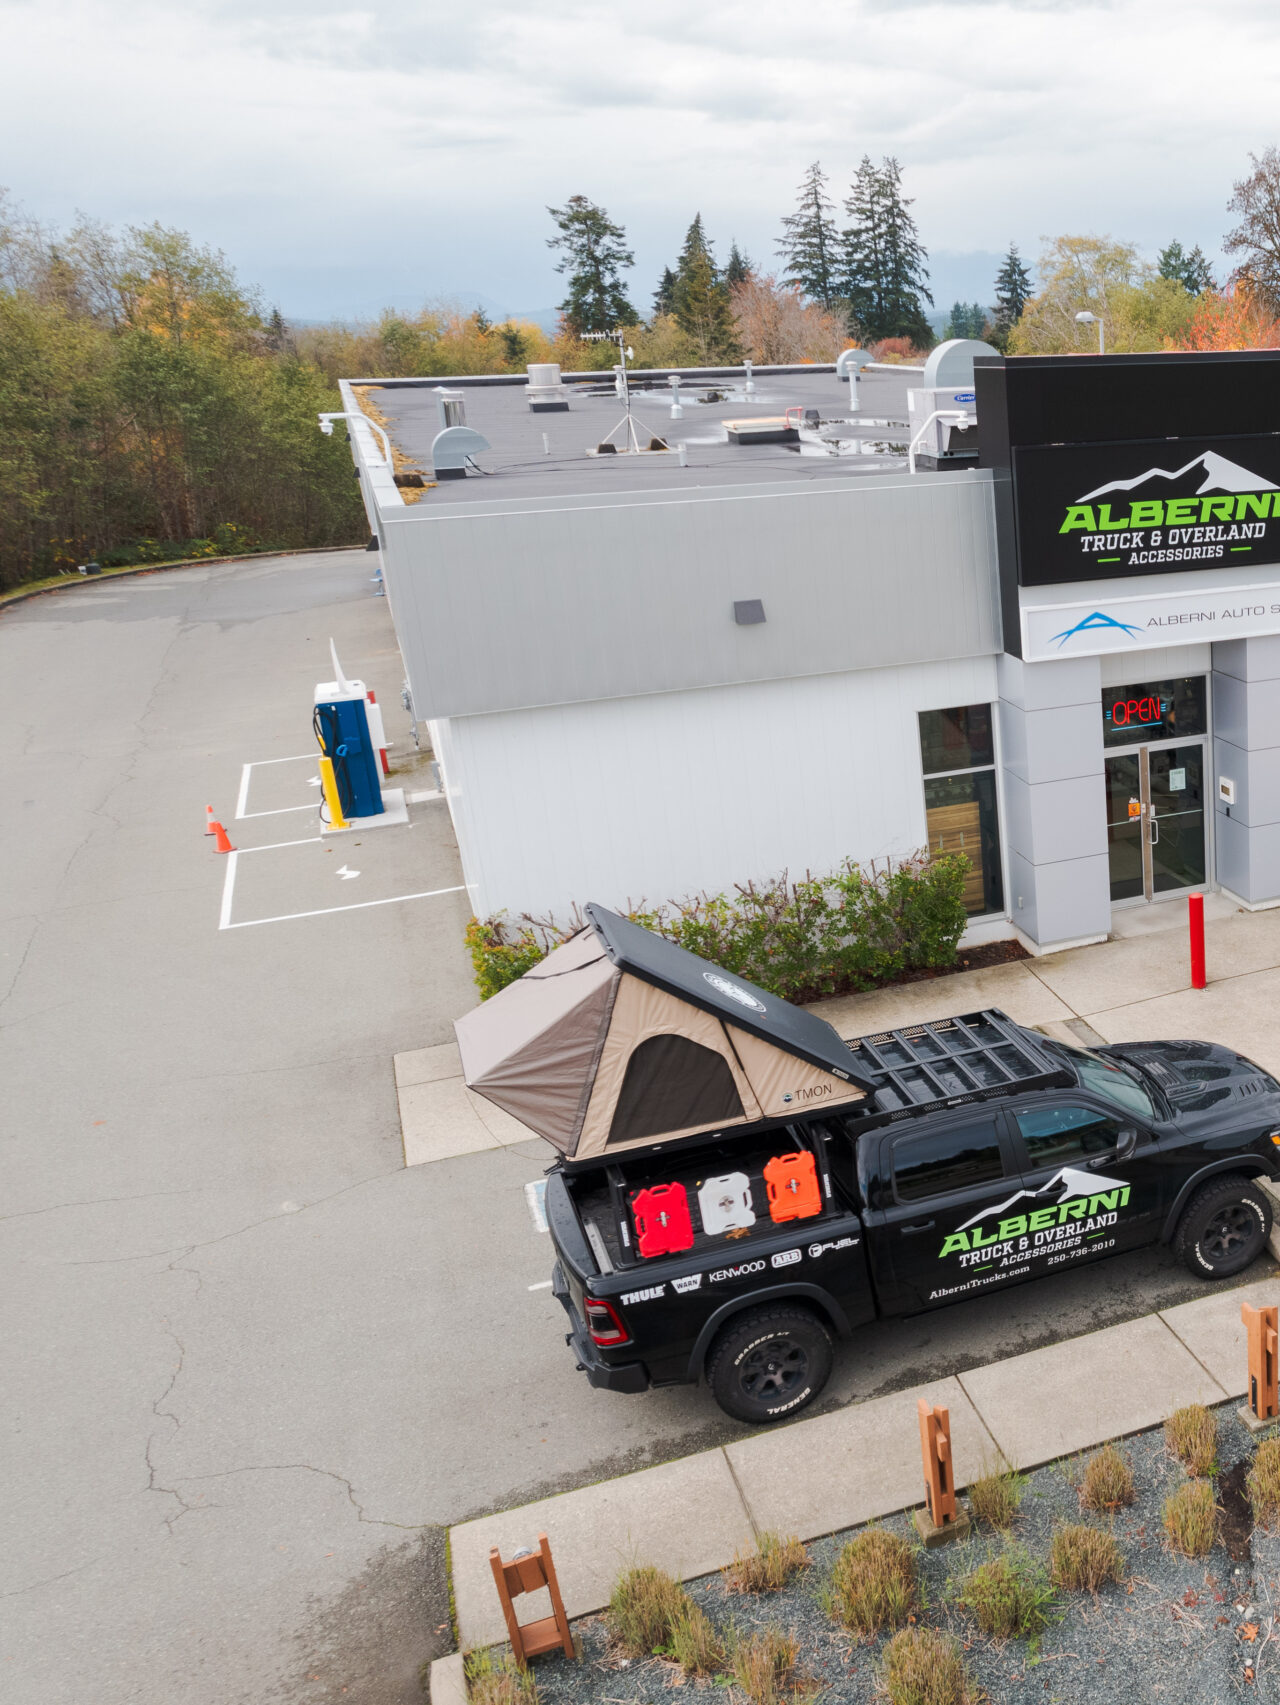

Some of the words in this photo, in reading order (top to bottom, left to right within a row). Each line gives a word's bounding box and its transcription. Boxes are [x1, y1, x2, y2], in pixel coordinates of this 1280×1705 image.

[1080, 531, 1145, 552] TRUCK
[1150, 530, 1162, 546] &
[1168, 522, 1266, 545] OVERLAND
[1128, 545, 1224, 565] ACCESSORIES
[1146, 612, 1216, 628] ALBERNI
[1221, 605, 1266, 620] AUTO
[1112, 697, 1160, 725] OPEN
[938, 1186, 1131, 1259] ALBERNI
[958, 1240, 1014, 1268] TRUCK
[1018, 1236, 1030, 1250] &
[1034, 1211, 1118, 1246] OVERLAND
[999, 1236, 1082, 1267] ACCESSORIES
[1047, 1238, 1116, 1266] 250-736-2010
[709, 1260, 766, 1283] KENWOOD
[773, 1251, 799, 1267] ARB
[620, 1285, 665, 1305] THULE
[676, 1278, 698, 1290] WARN
[929, 1265, 1030, 1300] AlberniTrucks.com
